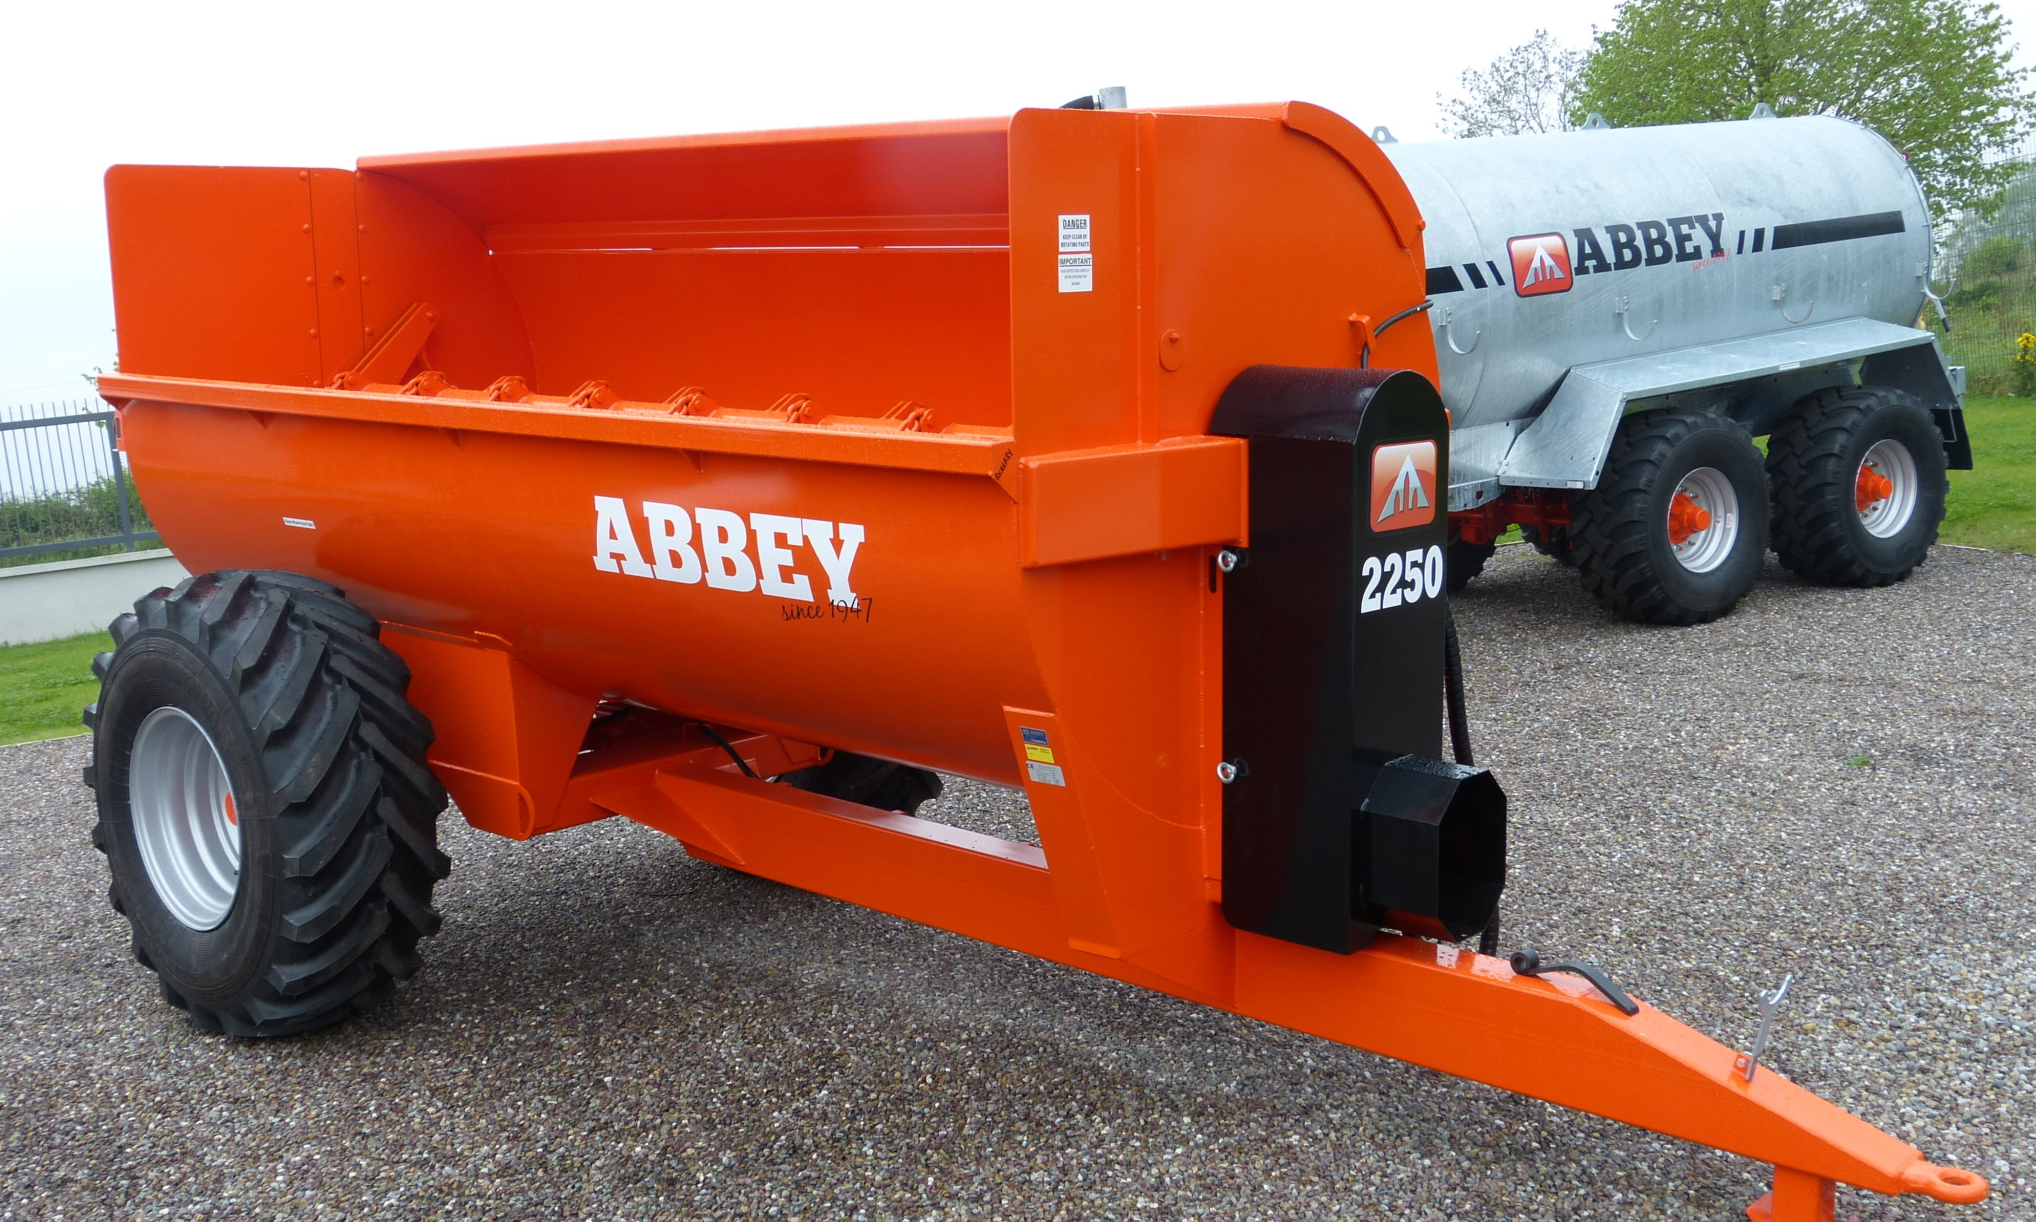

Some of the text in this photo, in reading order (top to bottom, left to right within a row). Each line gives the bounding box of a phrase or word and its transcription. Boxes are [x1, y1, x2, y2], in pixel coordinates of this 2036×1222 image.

[1063, 218, 1087, 228] DANGER
[1573, 212, 1725, 276] ABBEY
[1060, 257, 1091, 265] IMPORTANT
[592, 495, 865, 610] ABBEY
[1360, 545, 1444, 614] 2250
[782, 595, 873, 623] since 1947
